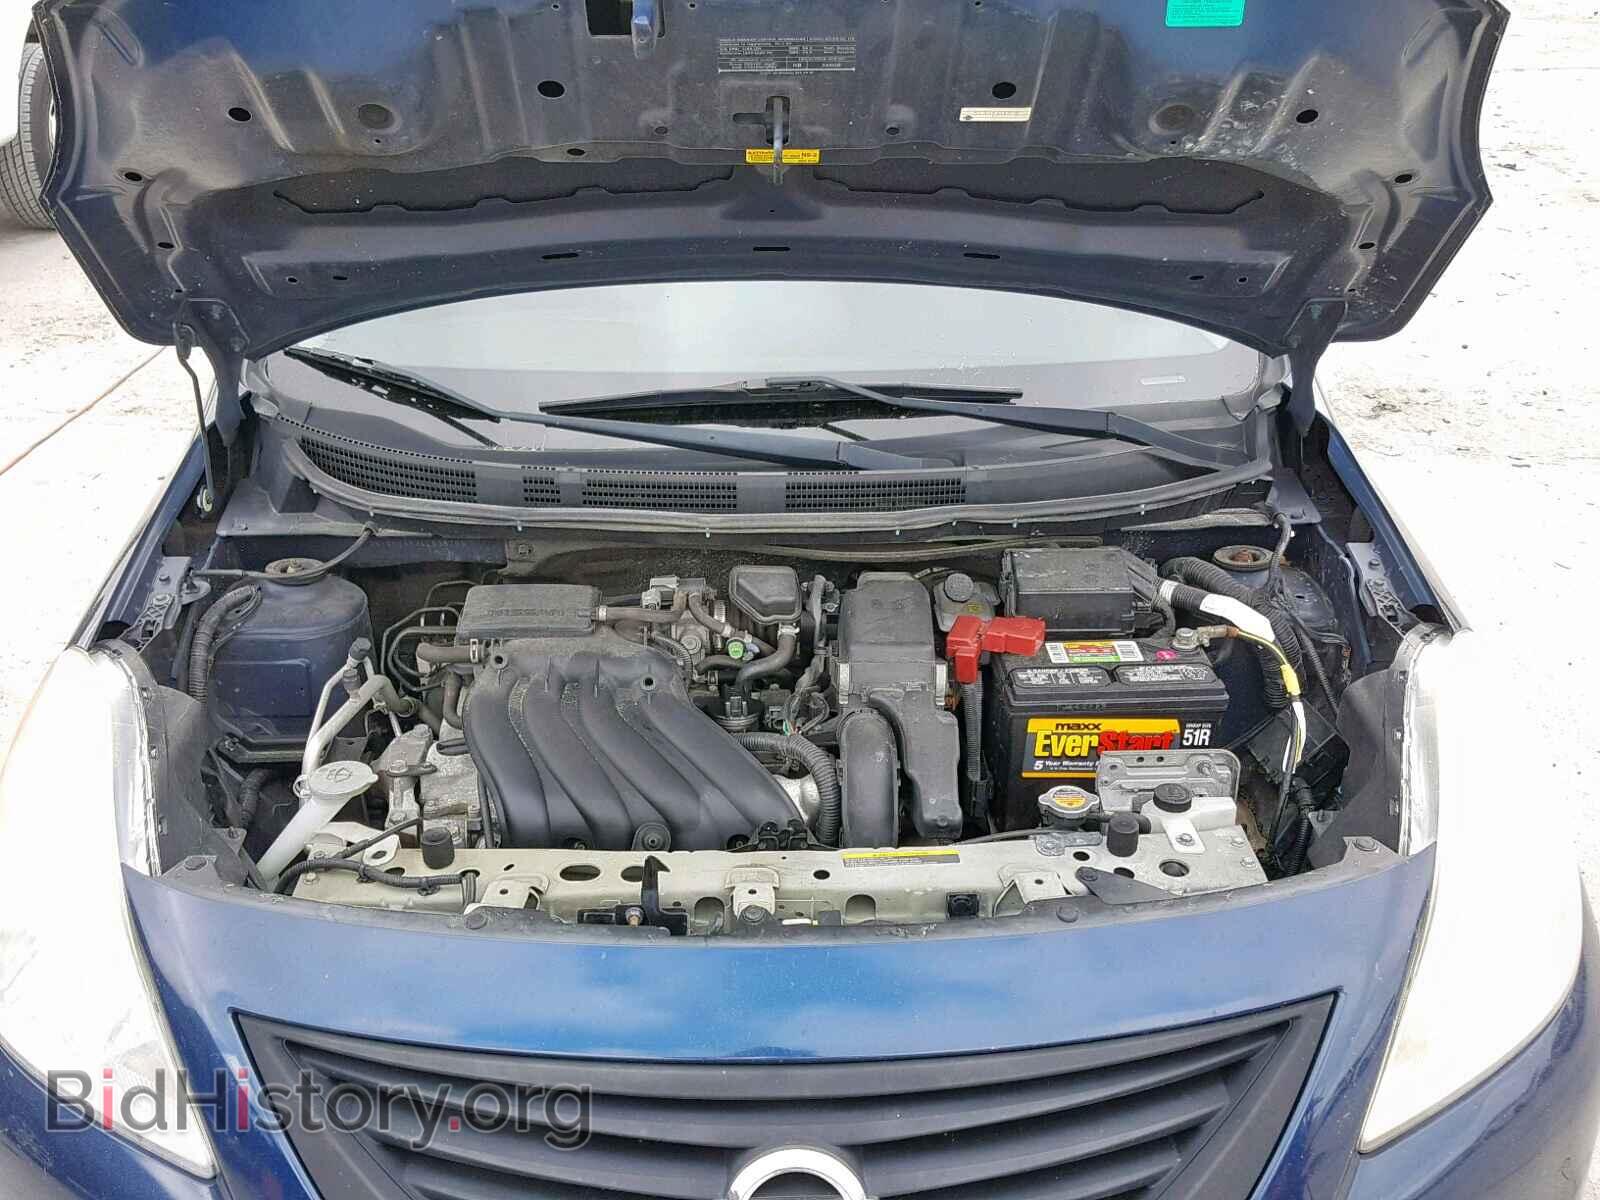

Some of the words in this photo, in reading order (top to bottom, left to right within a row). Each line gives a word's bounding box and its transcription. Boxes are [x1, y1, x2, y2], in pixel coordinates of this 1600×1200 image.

[1055, 722, 1102, 732] maxx
[1034, 730, 1174, 757] EverStart
[1182, 729, 1211, 746] 51R
[1033, 760, 1044, 770] 5
